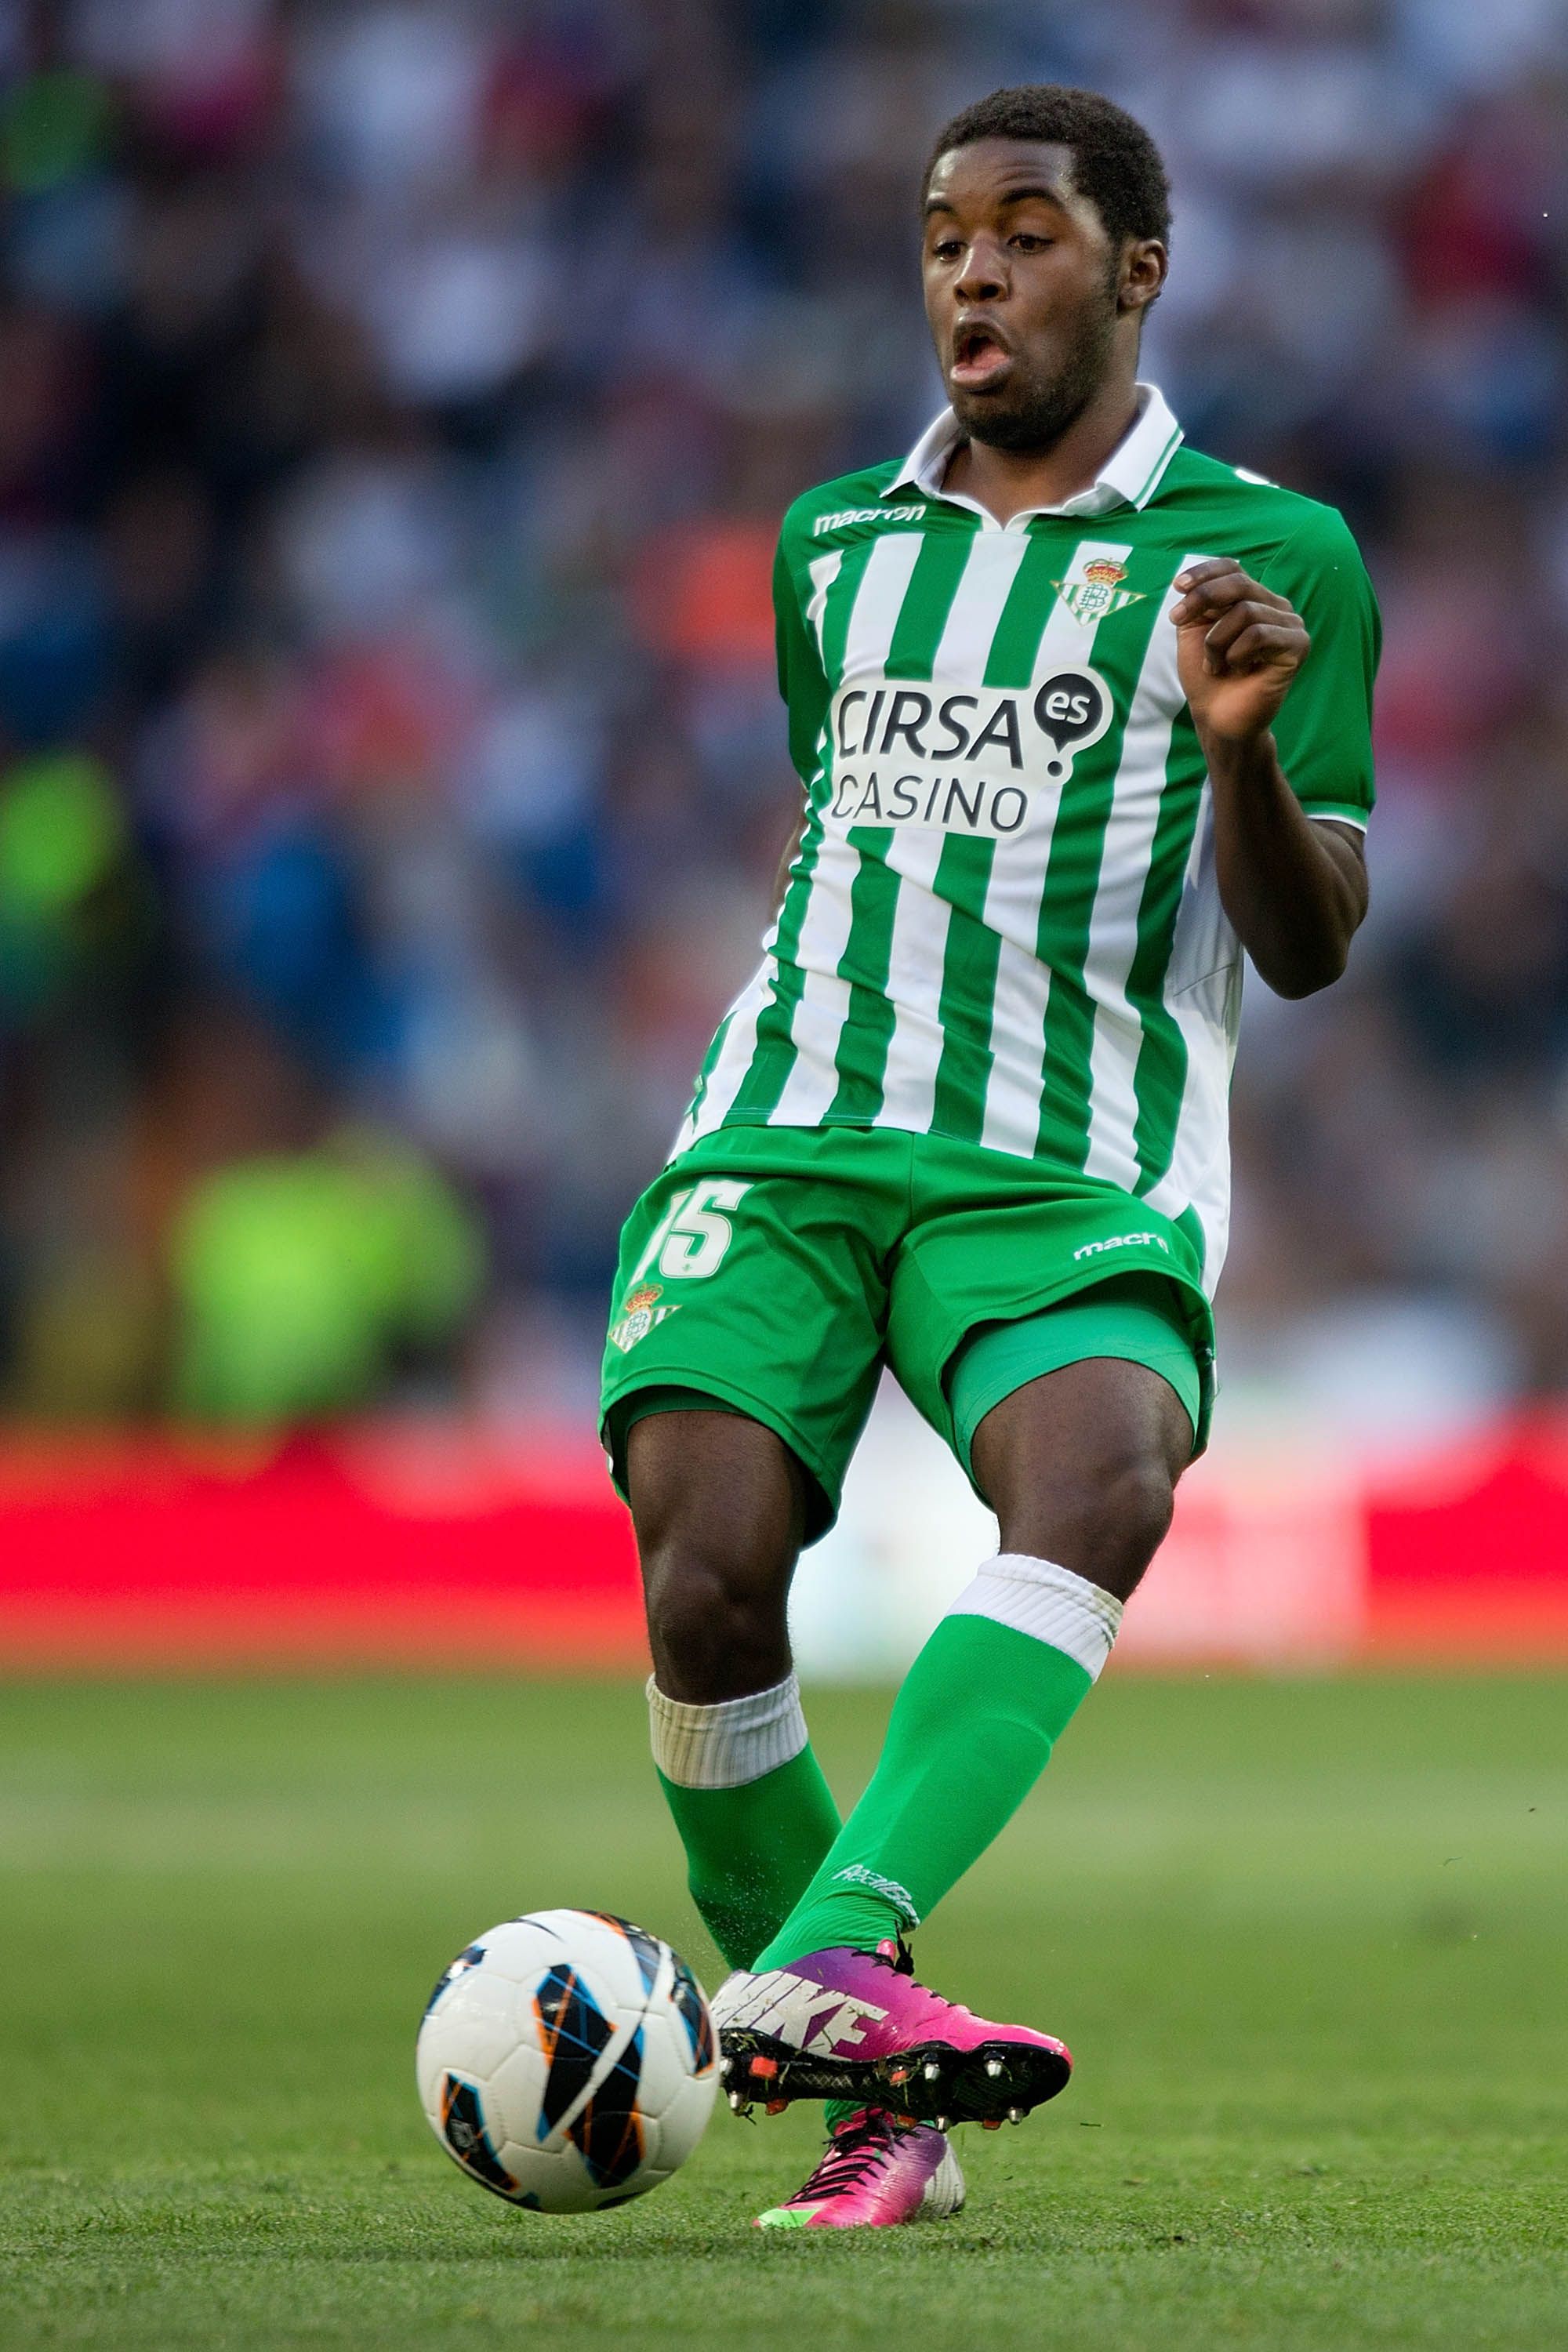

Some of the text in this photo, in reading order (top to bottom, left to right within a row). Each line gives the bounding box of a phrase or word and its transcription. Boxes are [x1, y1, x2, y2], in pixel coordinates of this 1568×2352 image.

[813, 504, 927, 537] macron
[837, 690, 1091, 770] CIRSA es
[831, 772, 1028, 833] CASINO
[629, 1180, 755, 1287] 15
